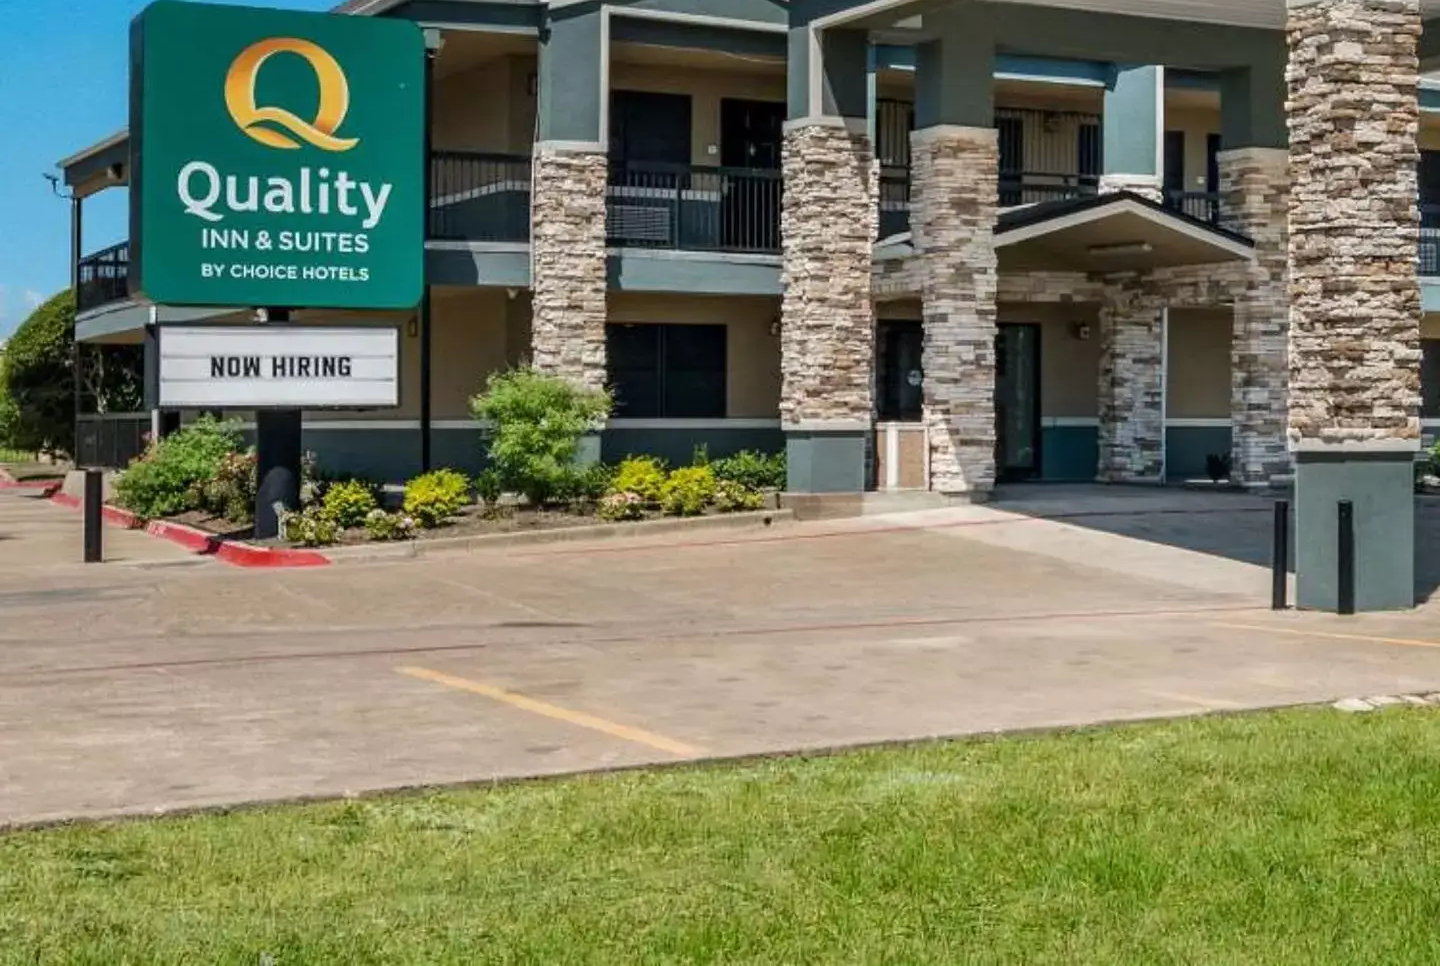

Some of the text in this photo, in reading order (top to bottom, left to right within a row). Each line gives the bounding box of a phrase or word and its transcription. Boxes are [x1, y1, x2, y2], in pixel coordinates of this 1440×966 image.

[224, 37, 360, 152] Q
[177, 160, 393, 229] Quality
[202, 228, 370, 253] INN & SUITES
[201, 262, 370, 282] BY CHOICE HOTELS
[210, 355, 352, 378] NOW HIRING
